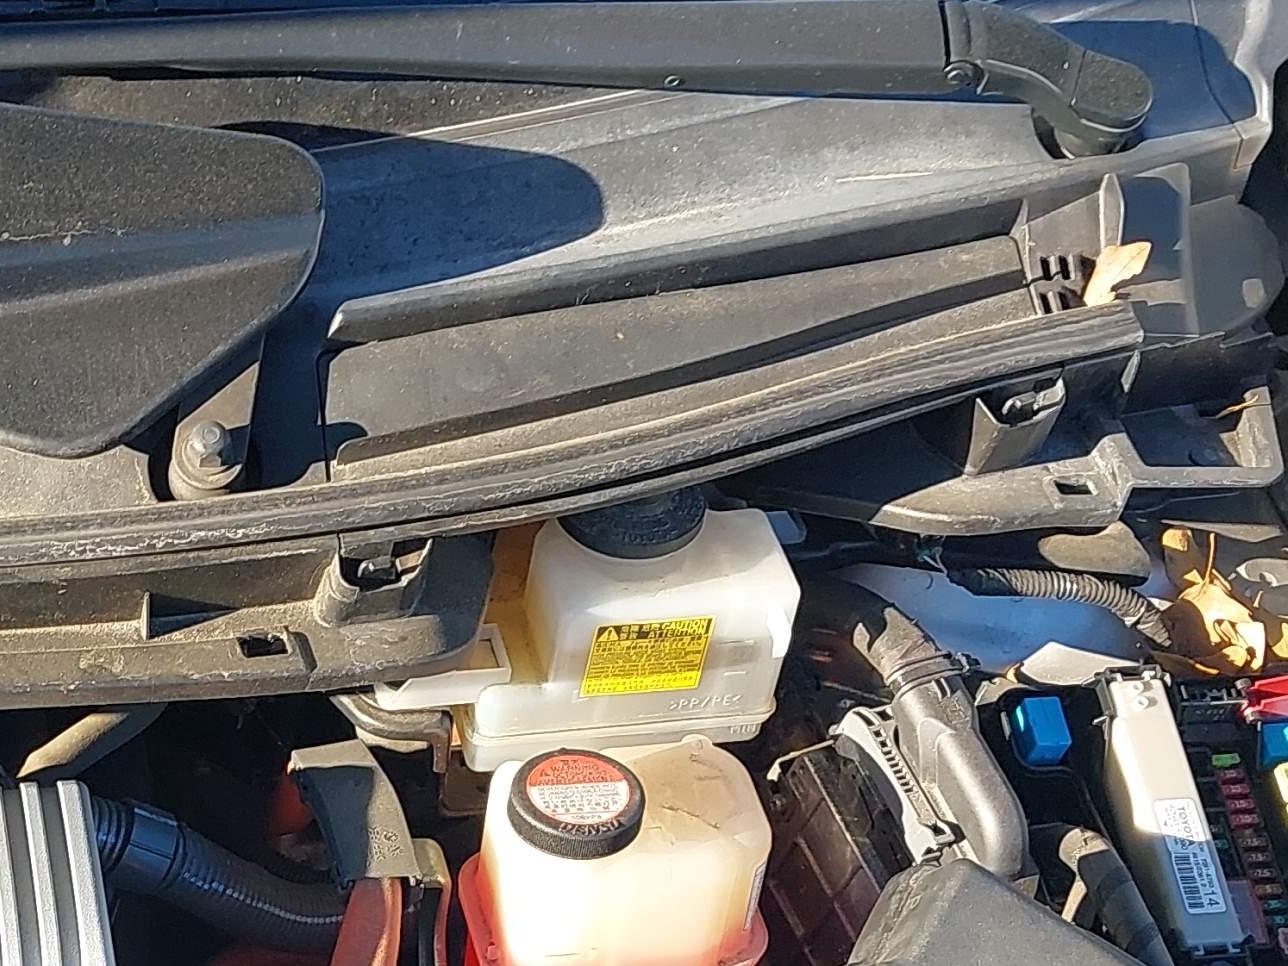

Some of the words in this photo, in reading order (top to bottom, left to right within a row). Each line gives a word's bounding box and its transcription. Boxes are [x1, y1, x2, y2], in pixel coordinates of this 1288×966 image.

[661, 619, 708, 631] CAUTION
[1178, 806, 1196, 847] TOYOTA
[1203, 889, 1221, 907] 14
